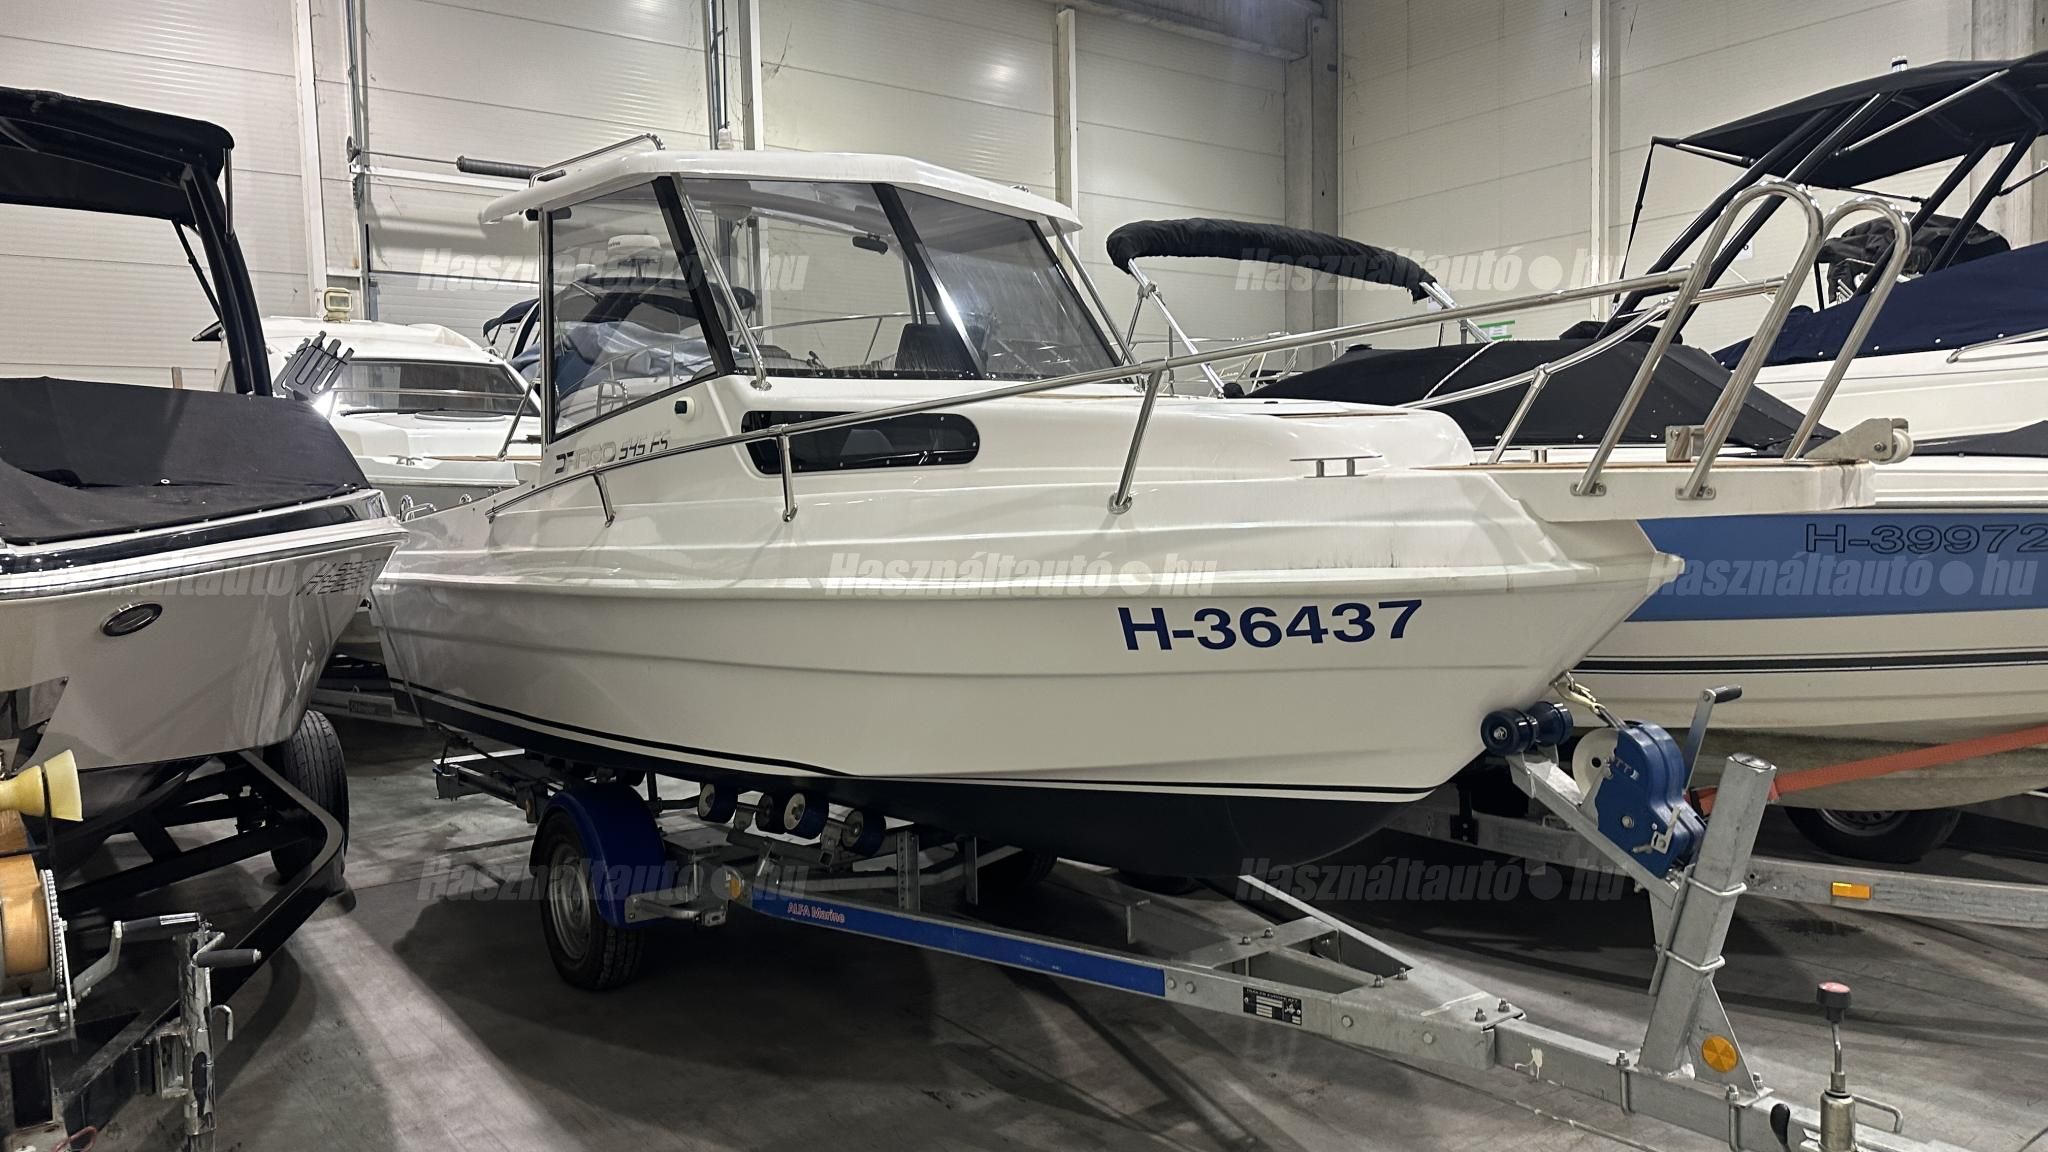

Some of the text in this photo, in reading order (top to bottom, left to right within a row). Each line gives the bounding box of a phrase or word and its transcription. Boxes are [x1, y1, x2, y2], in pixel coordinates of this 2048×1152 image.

[1805, 523, 2048, 554] H-39972
[1117, 599, 1423, 651] H-36437
[787, 902, 845, 924] ALFA Marine
